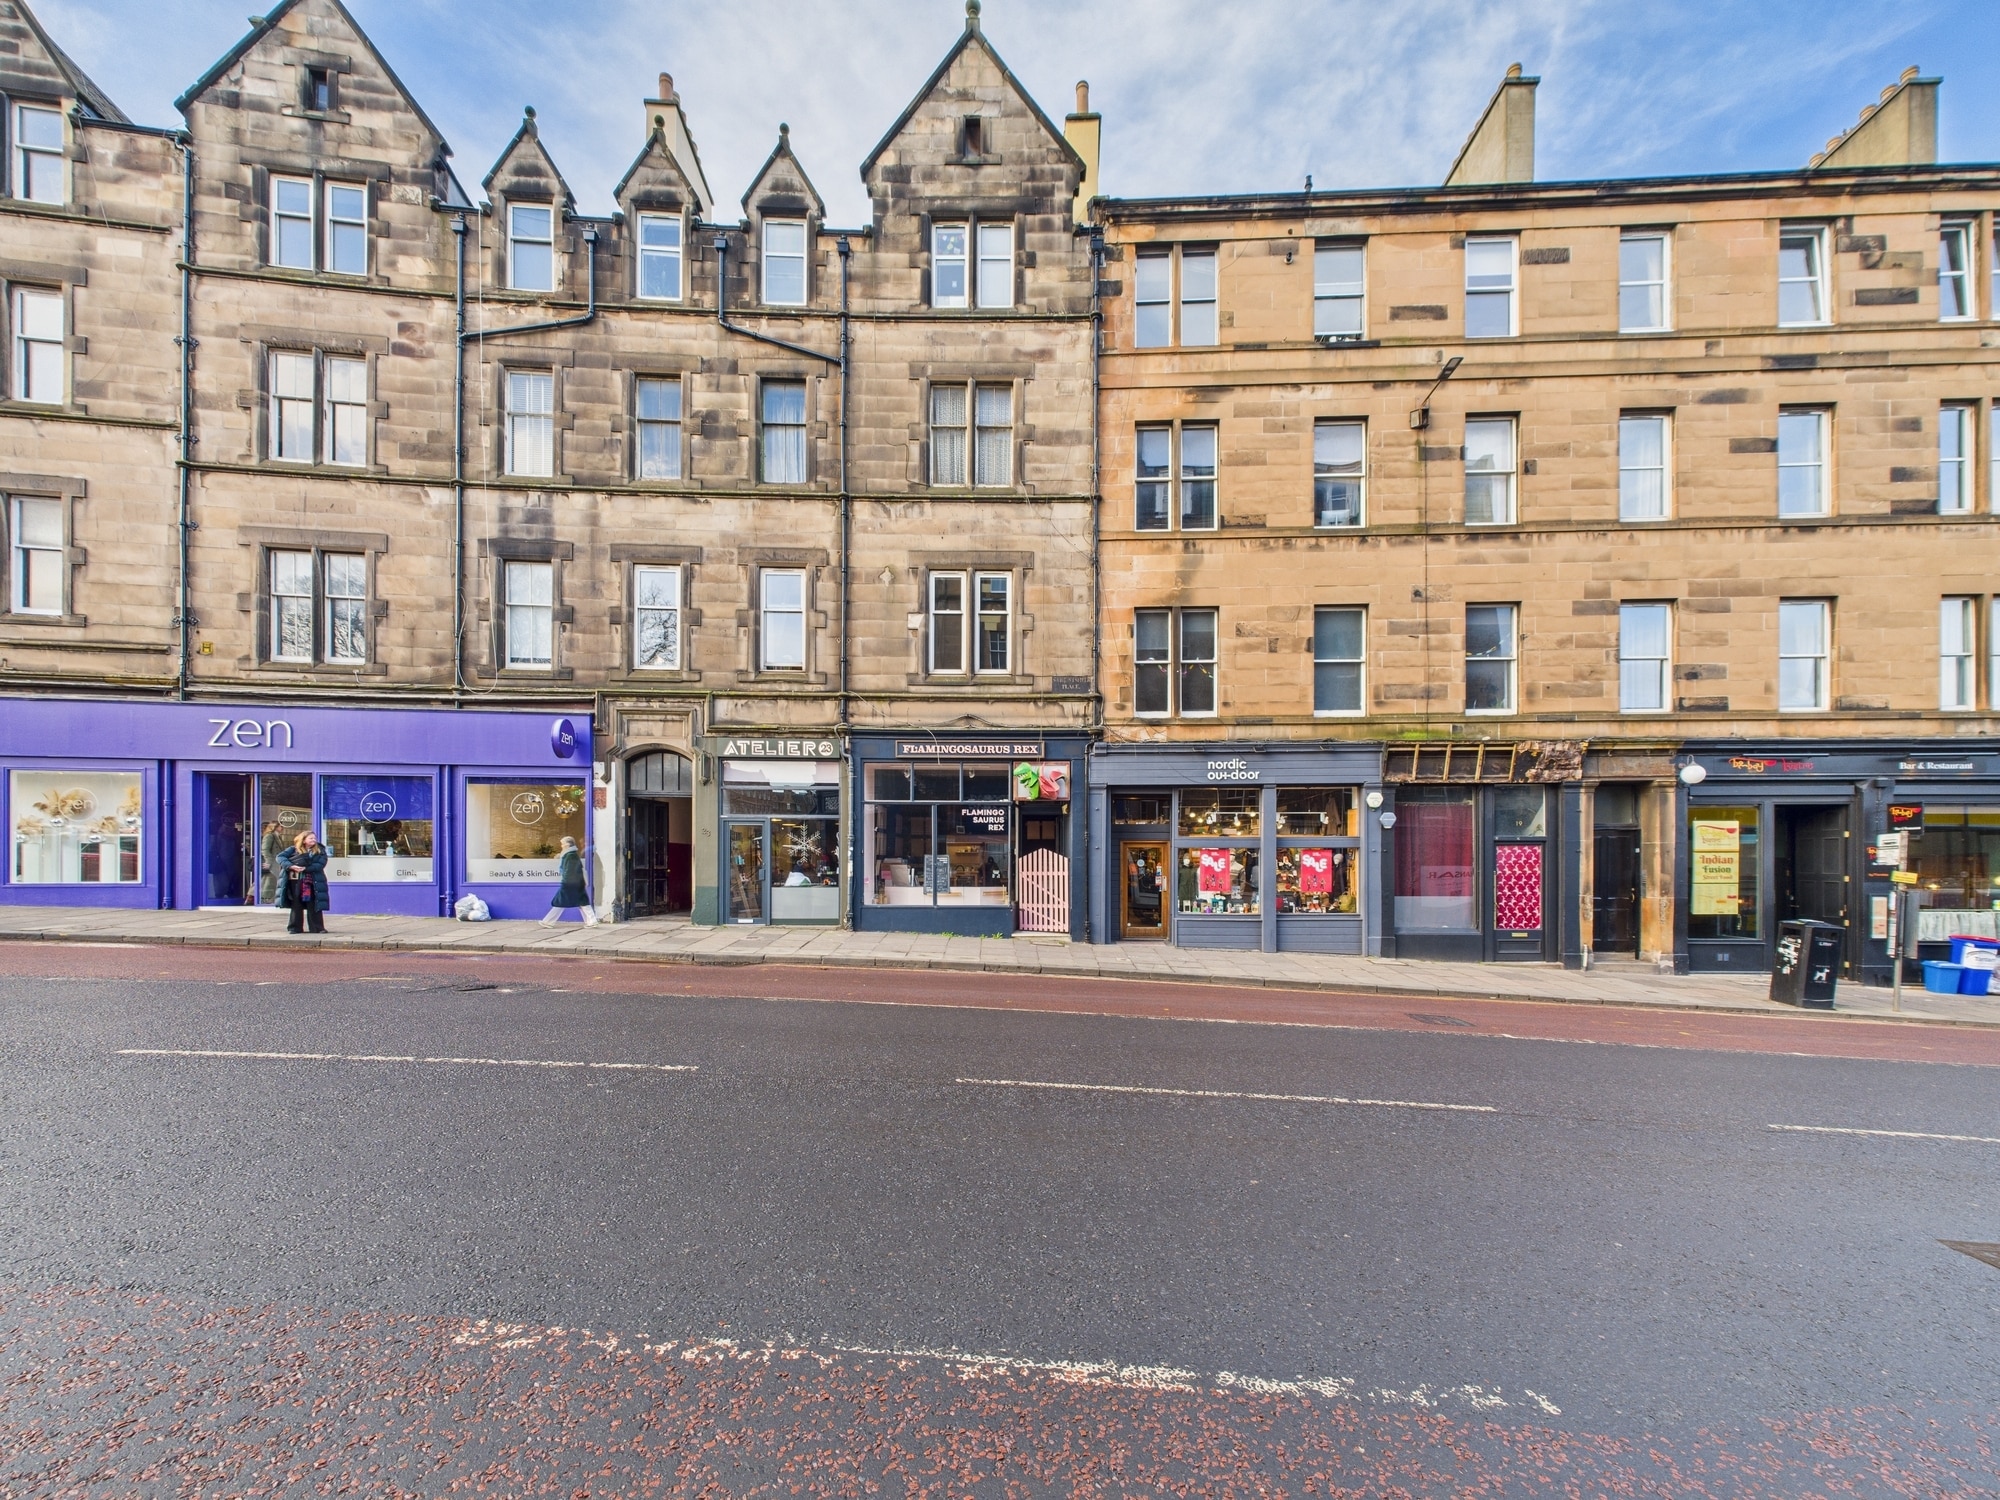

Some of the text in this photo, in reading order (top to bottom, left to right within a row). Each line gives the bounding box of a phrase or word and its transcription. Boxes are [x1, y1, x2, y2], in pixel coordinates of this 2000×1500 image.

[208, 719, 292, 748] zen
[560, 732, 574, 746] zen
[723, 740, 832, 756] ATELIER 23
[903, 745, 1038, 754] FLAMINGOSAURUS REX
[1207, 758, 1247, 769] nordic
[365, 802, 392, 812] zen
[515, 803, 540, 813] zen
[1201, 854, 1226, 872] SALE
[1302, 854, 1328, 872] SALE
[1699, 855, 1733, 864] Indian
[1702, 865, 1731, 873] Fusion
[489, 870, 515, 879] Beauty
